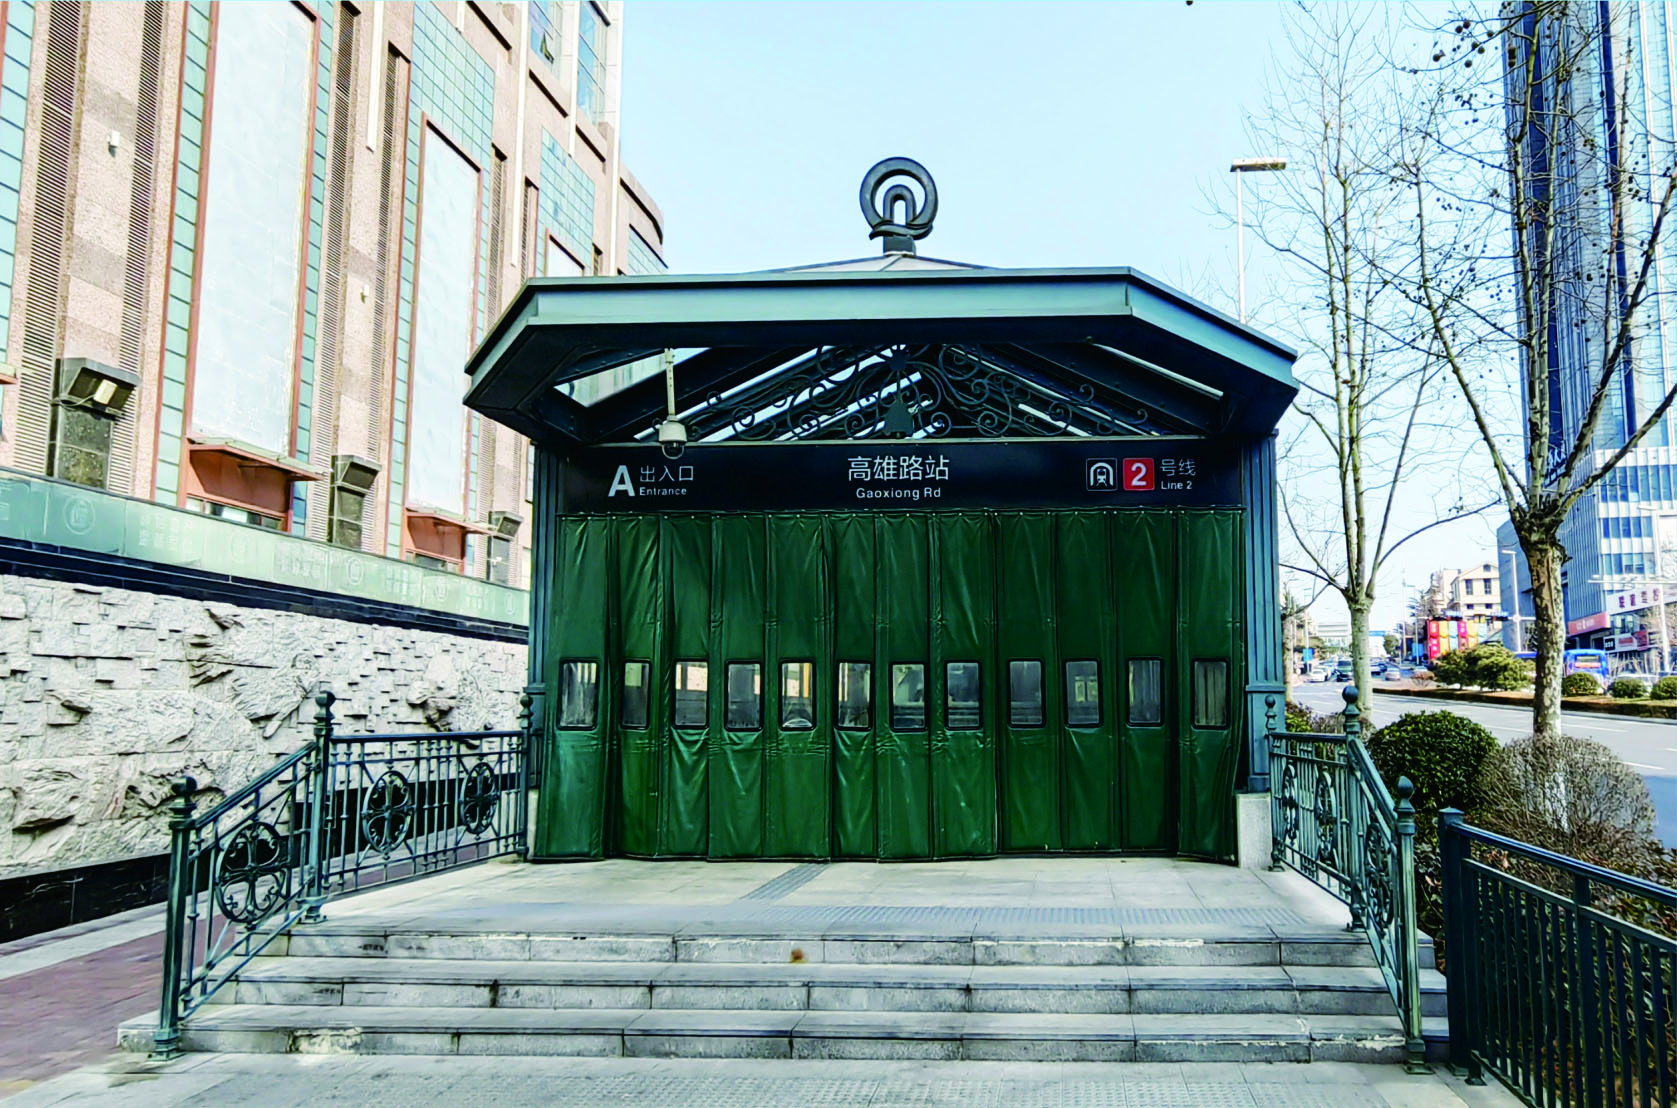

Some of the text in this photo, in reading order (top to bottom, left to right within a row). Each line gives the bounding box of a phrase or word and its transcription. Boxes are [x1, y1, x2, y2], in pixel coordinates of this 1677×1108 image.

[847, 454, 950, 481] 高雄路站
[1131, 458, 1197, 487] 2 号线
[608, 465, 694, 497] A 出入口
[639, 486, 687, 496] Entrance
[1161, 480, 1193, 490] Line 2
[856, 487, 941, 501] Gaoxiong Rd
